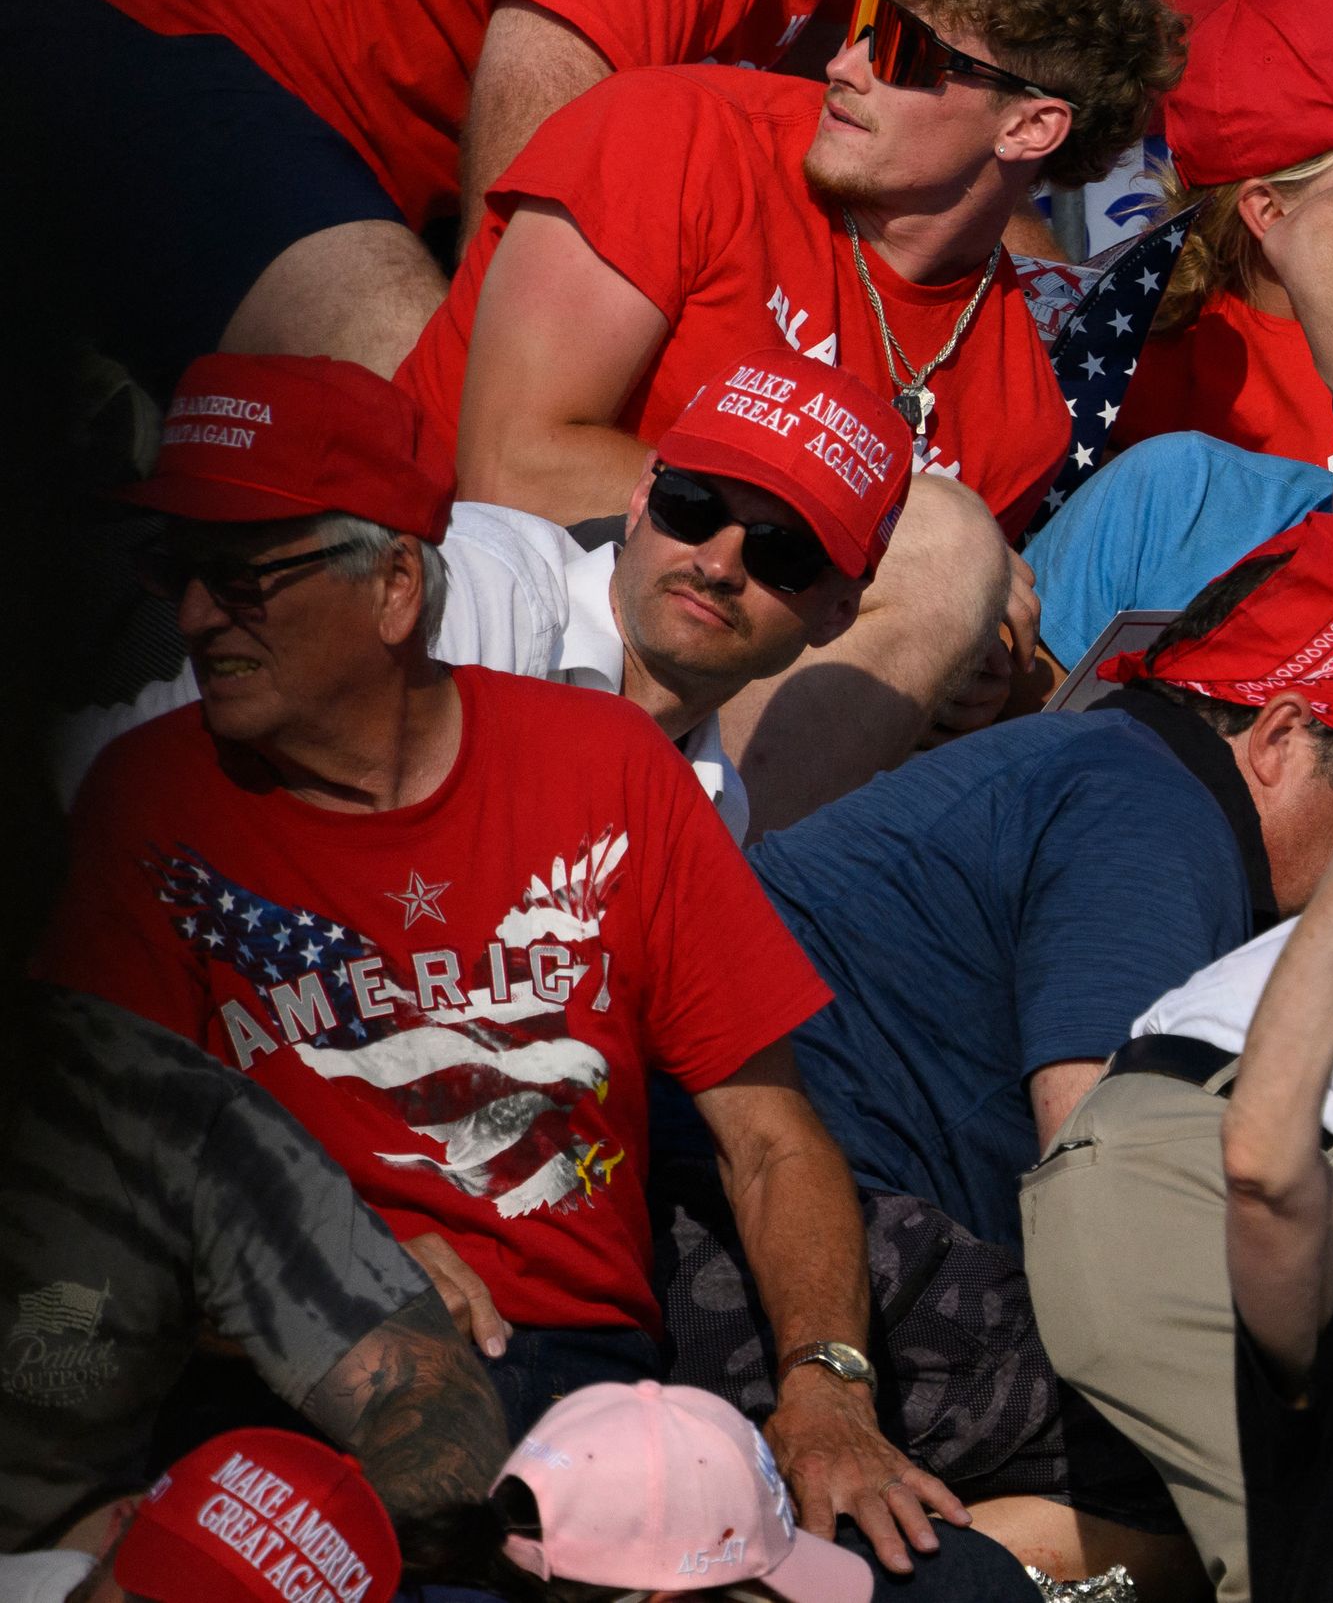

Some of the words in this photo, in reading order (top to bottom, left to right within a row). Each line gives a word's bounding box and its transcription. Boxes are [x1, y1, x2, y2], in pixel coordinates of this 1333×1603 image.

[766, 284, 809, 351] ALL
[191, 424, 256, 450] AGAIN
[716, 392, 800, 437] GREAT
[804, 432, 873, 499] AGAIN
[725, 365, 797, 404] MAKE
[799, 392, 894, 483] AMERICA
[197, 1493, 285, 1569] GREAT
[211, 1453, 295, 1519] MAKE
[274, 1500, 373, 1603] AMERICA
[675, 1538, 747, 1577] 45-47
